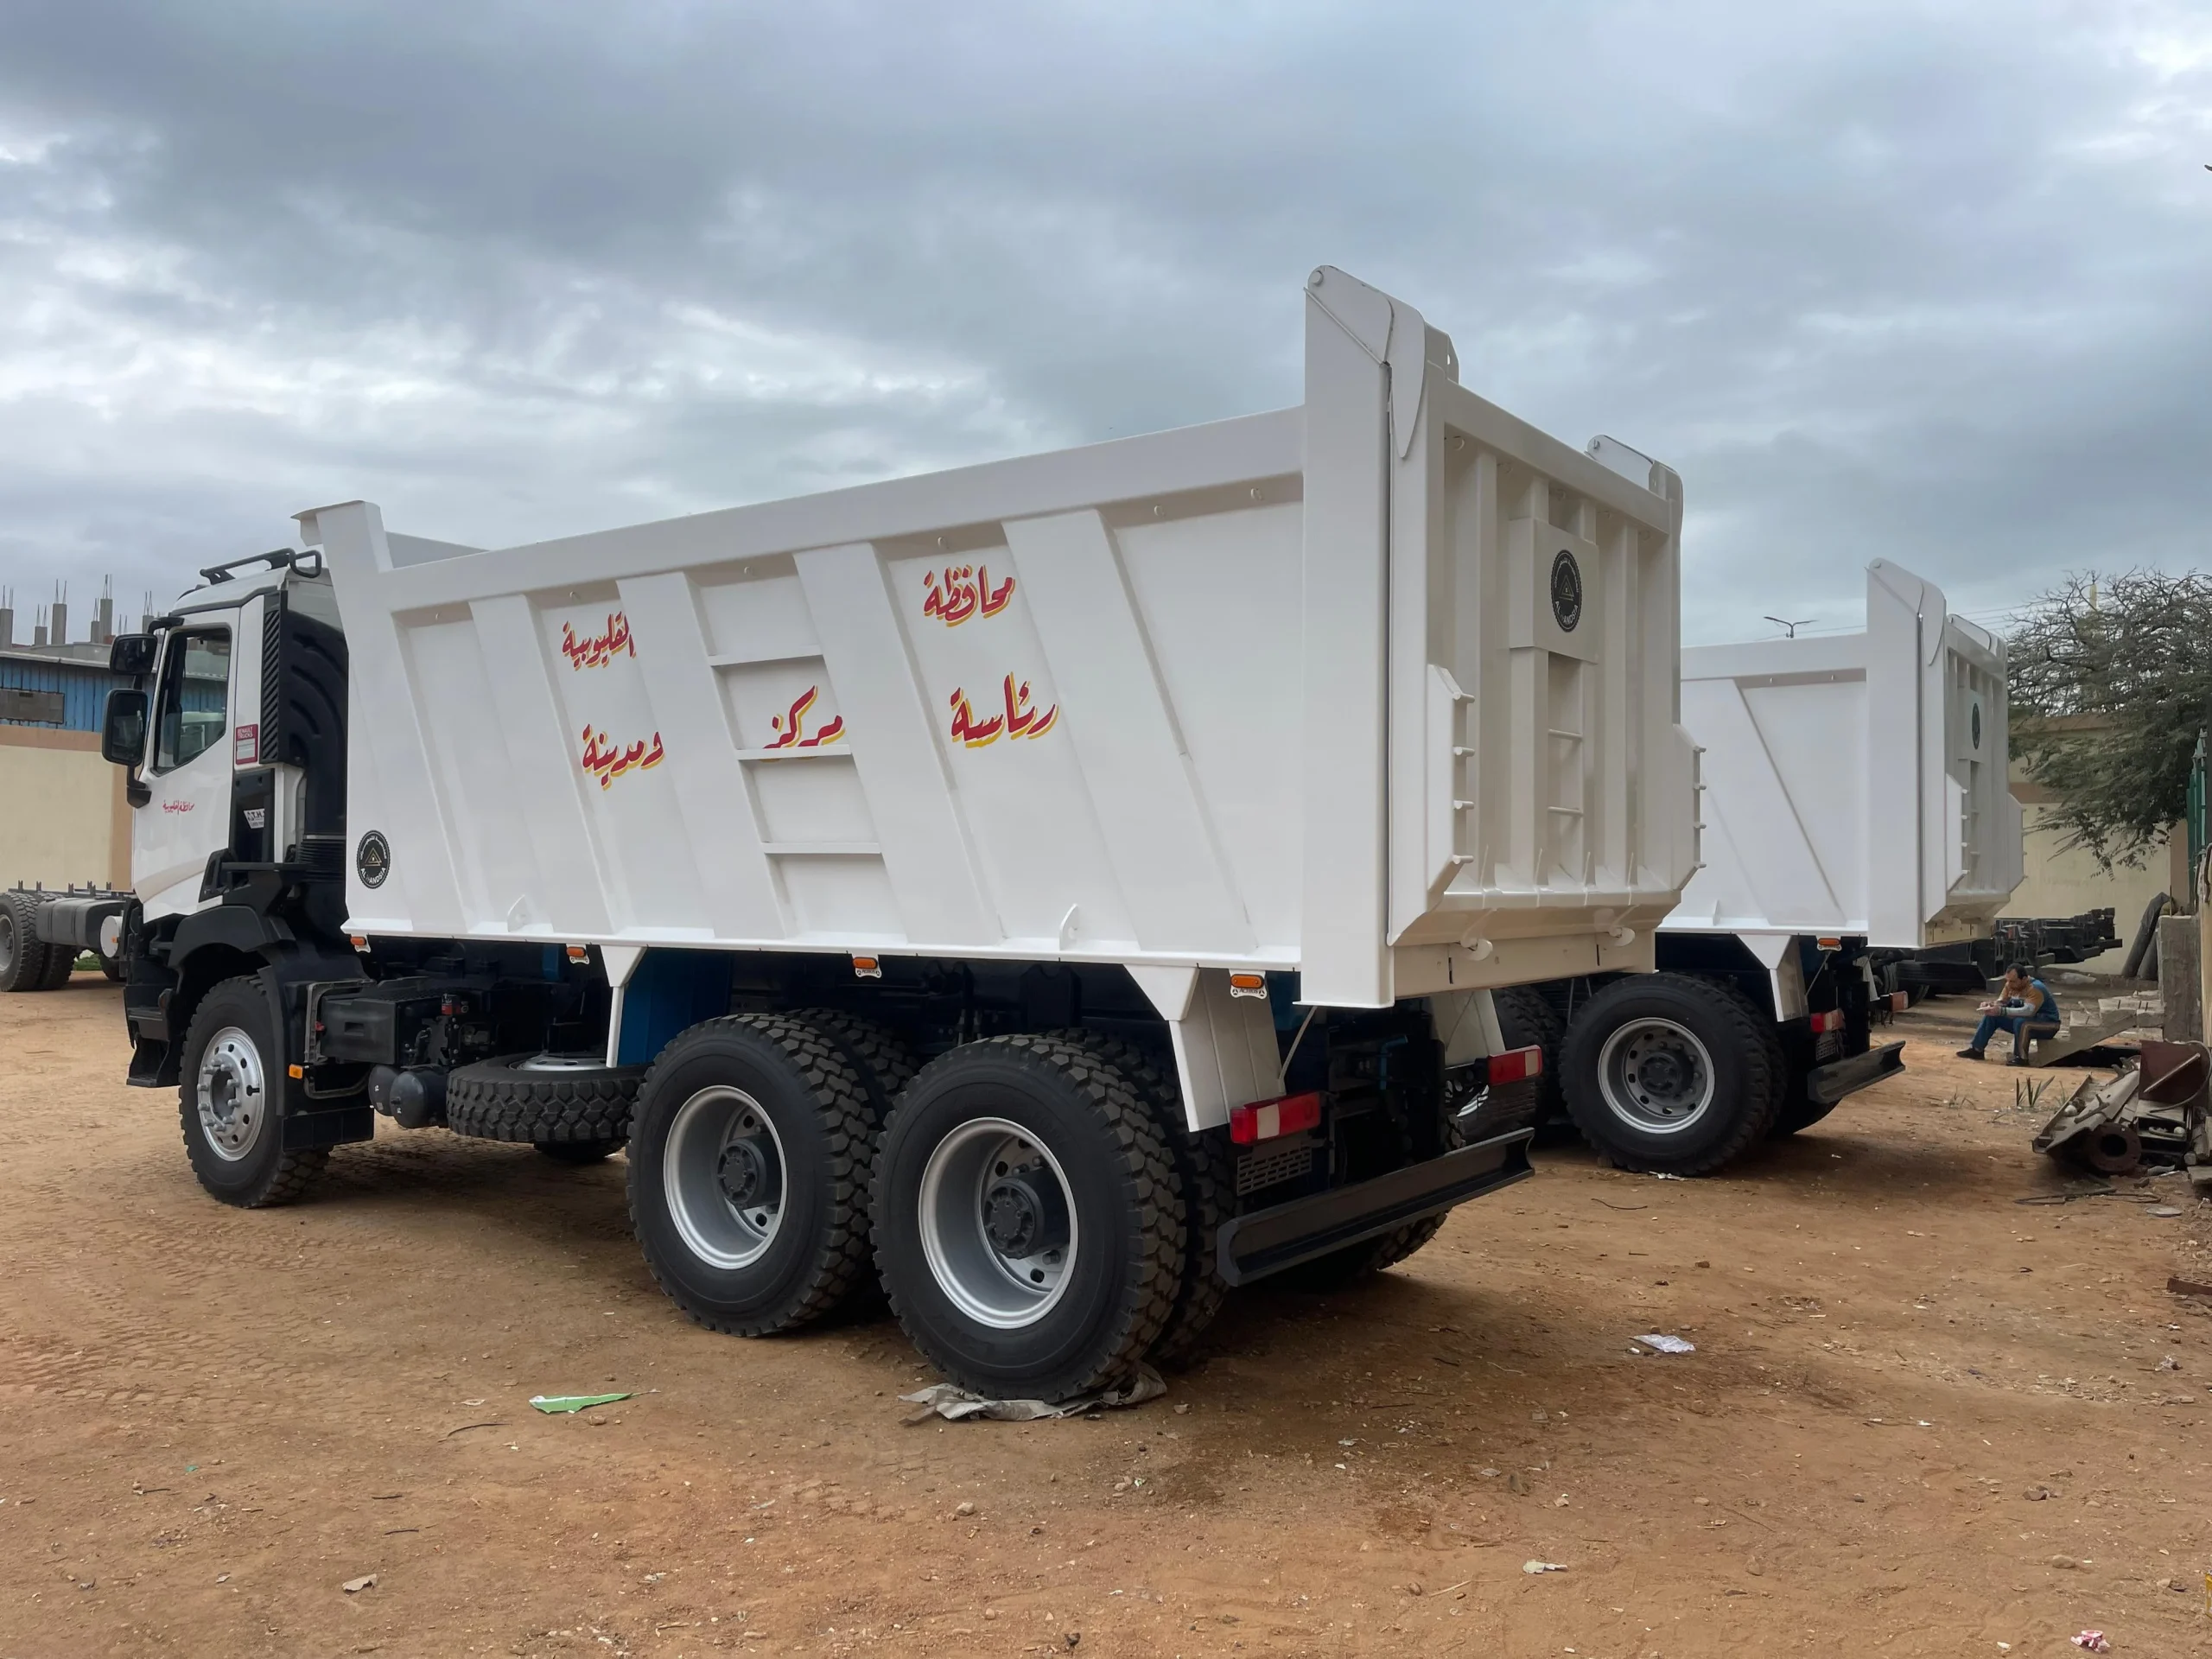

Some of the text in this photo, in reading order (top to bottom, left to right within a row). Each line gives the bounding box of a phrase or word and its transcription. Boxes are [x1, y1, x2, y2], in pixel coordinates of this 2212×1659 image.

[563, 564, 1016, 671] محافظة القليوبية
[763, 685, 845, 761] مركز
[950, 671, 1058, 749] رئاسة
